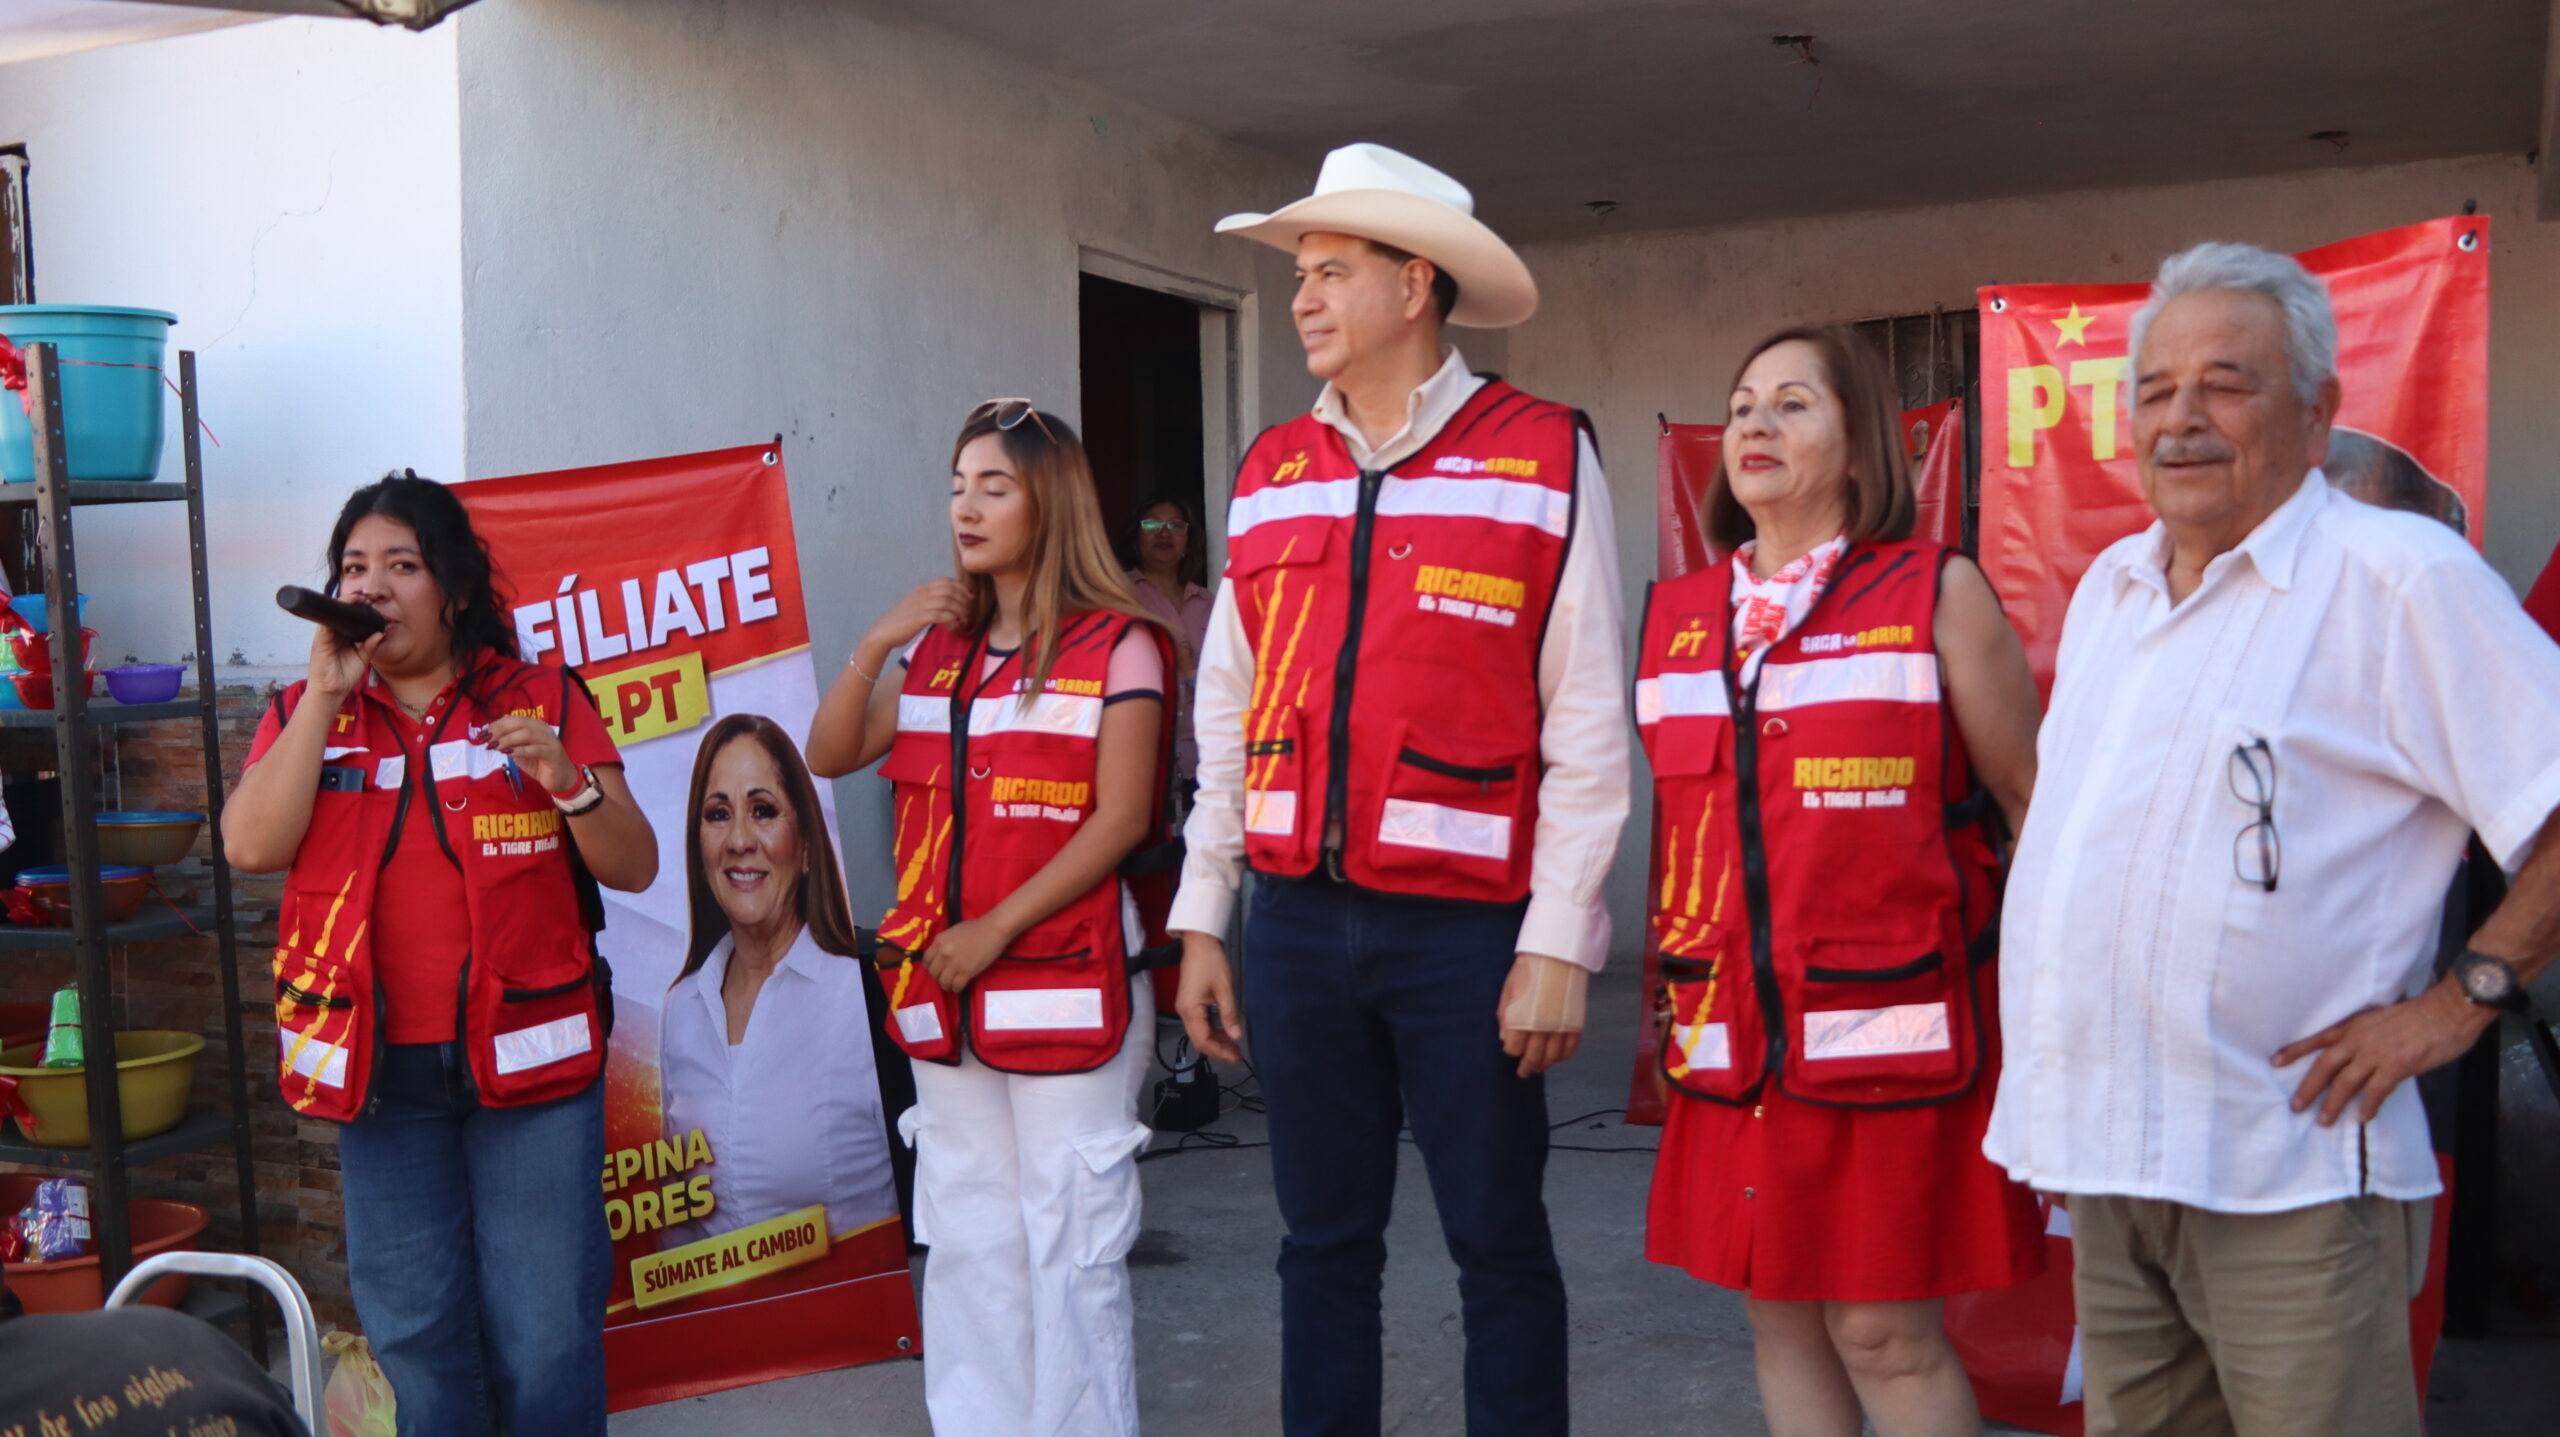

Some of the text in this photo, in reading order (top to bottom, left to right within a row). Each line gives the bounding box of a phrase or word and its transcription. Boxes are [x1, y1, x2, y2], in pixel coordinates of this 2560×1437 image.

[2007, 356, 2131, 467] PT
[1272, 458, 1309, 482] PT
[1433, 456, 1474, 474] SACA
[1485, 457, 1538, 477] GARRA
[1414, 564, 1526, 609] RICARDO
[513, 546, 778, 667] FÍLIATE
[1417, 594, 1437, 612] EL
[1438, 597, 1476, 620] TIGRE
[1667, 630, 1707, 657] PT
[1800, 632, 1843, 654] SACA
[1857, 625, 1914, 648] GARRA
[1056, 678, 1103, 695] GARRA
[617, 669, 682, 735] PT
[336, 713, 356, 734] T
[1793, 757, 1915, 790] RICARDO
[991, 776, 1088, 805] RICARDO
[1802, 791, 1821, 808] EL
[1823, 791, 1864, 808] TIGRE
[472, 808, 560, 841] RICARDO
[994, 803, 1007, 817] EL
[1008, 803, 1042, 818] TIGRE
[482, 843, 498, 856] EL
[501, 841, 533, 856] TIGRE
[601, 1128, 714, 1193] EPINA
[604, 1174, 715, 1241] ORES
[644, 1222, 817, 1293] SÚMATE AL CAMBIO
